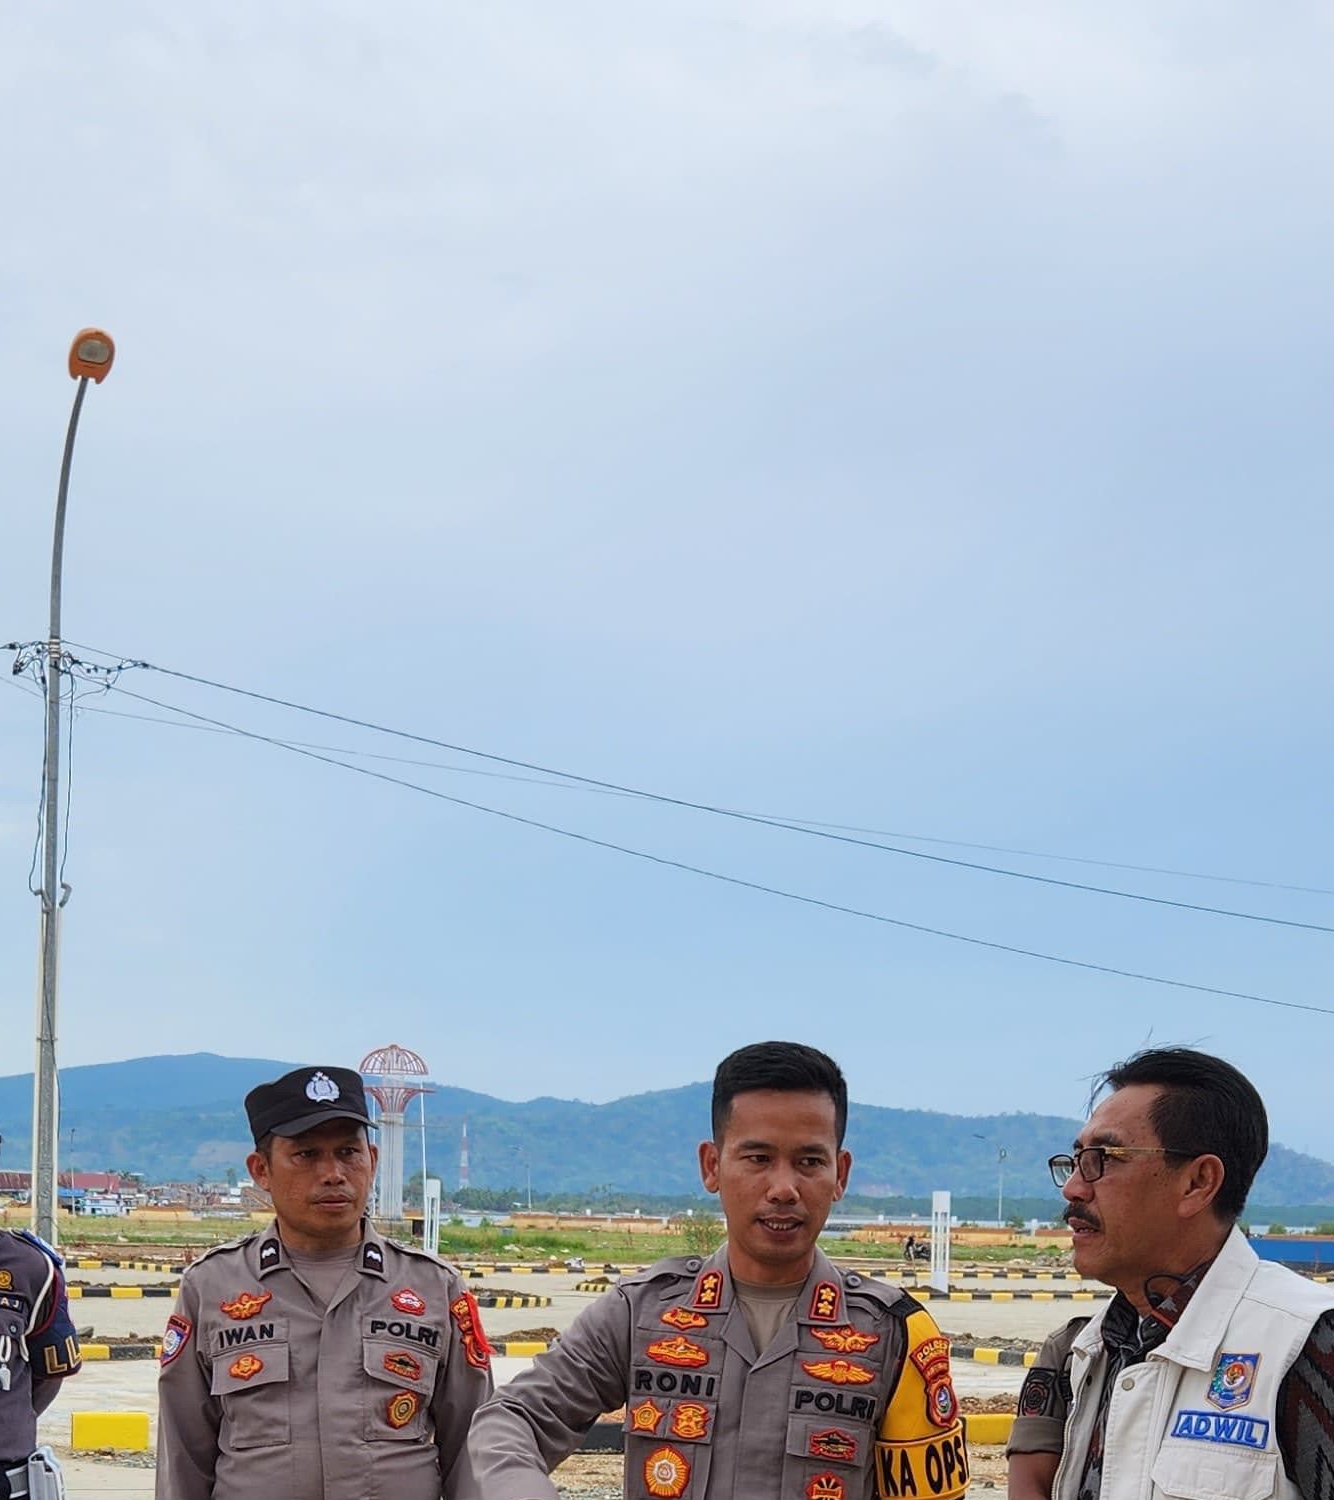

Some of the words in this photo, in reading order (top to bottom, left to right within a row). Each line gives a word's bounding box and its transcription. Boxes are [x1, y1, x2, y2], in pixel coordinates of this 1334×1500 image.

[218, 1323, 275, 1349] IWAN
[371, 1319, 439, 1348] POLRI
[634, 1370, 717, 1397] RONI
[794, 1390, 875, 1420] POLRI
[880, 1448, 917, 1497] KA
